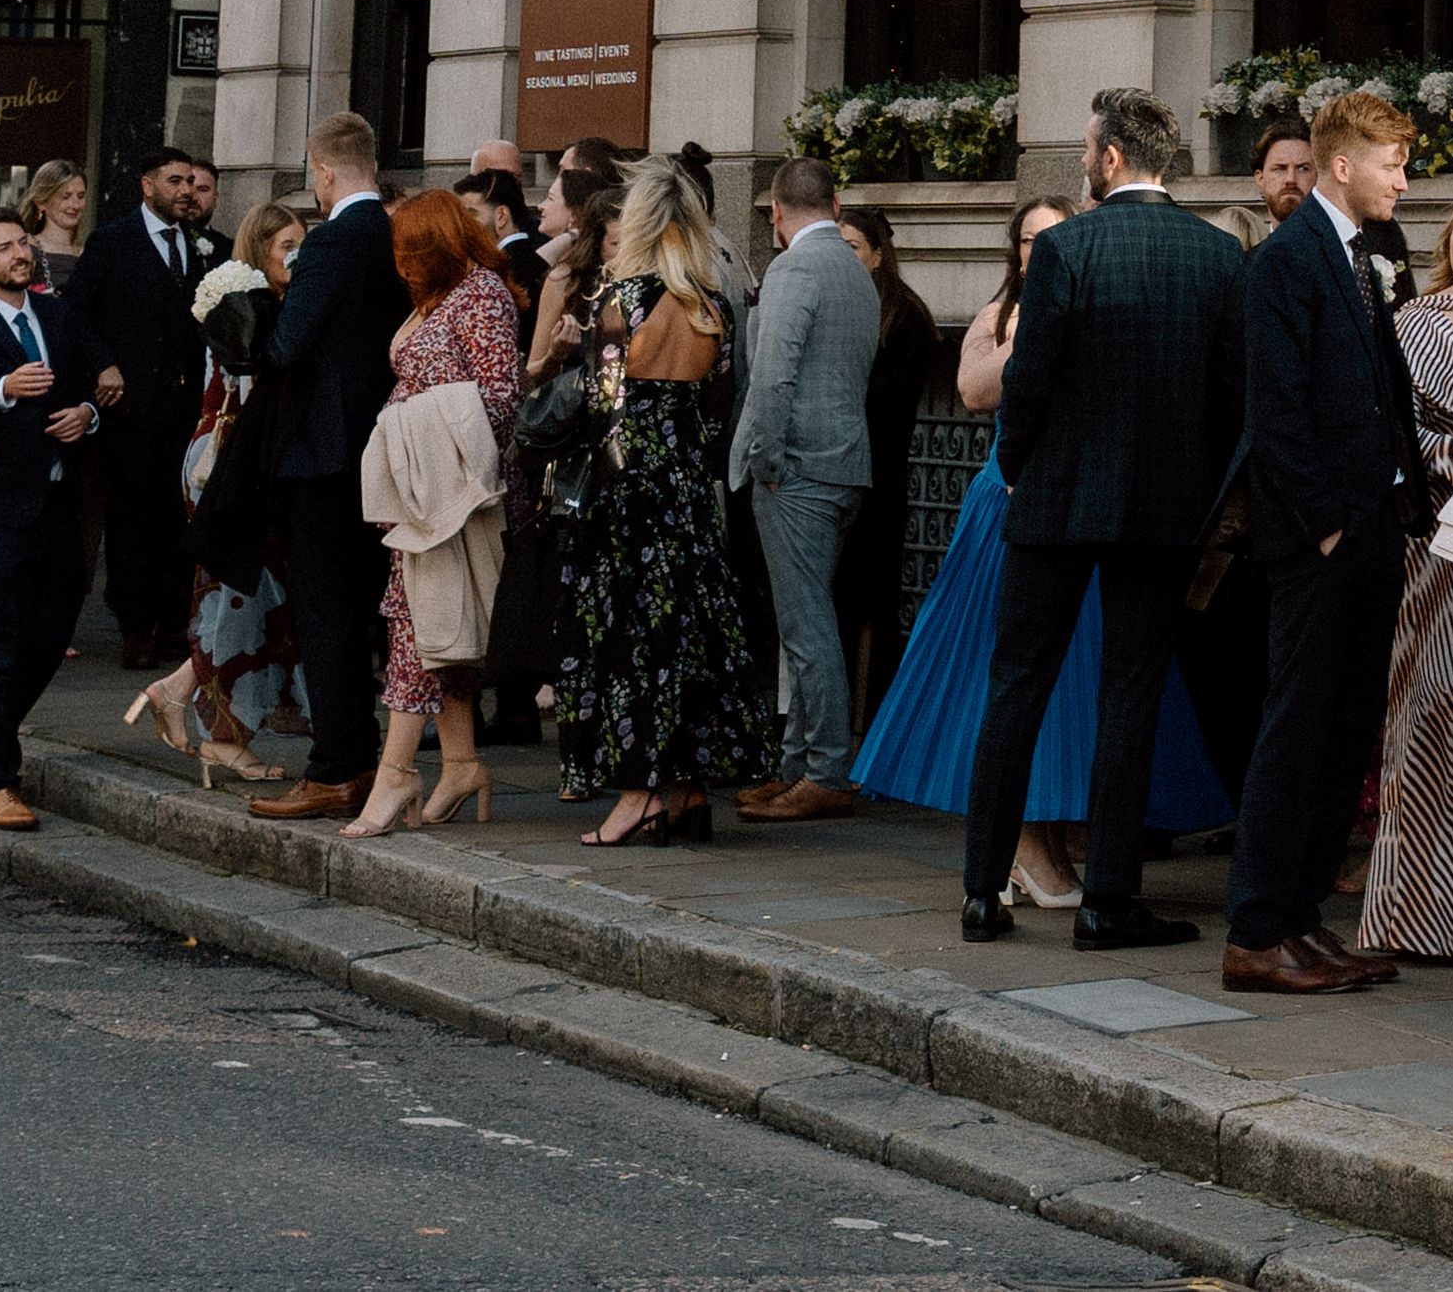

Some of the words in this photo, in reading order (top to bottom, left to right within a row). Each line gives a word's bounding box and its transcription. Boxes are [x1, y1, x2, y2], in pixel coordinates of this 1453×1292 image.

[534, 50, 555, 62] WINE
[556, 47, 593, 61] TASTINGS
[599, 44, 629, 58] EVENTS
[526, 76, 565, 89] SEASONAL
[567, 74, 589, 86] MENU
[595, 71, 637, 84] WEDDINGS
